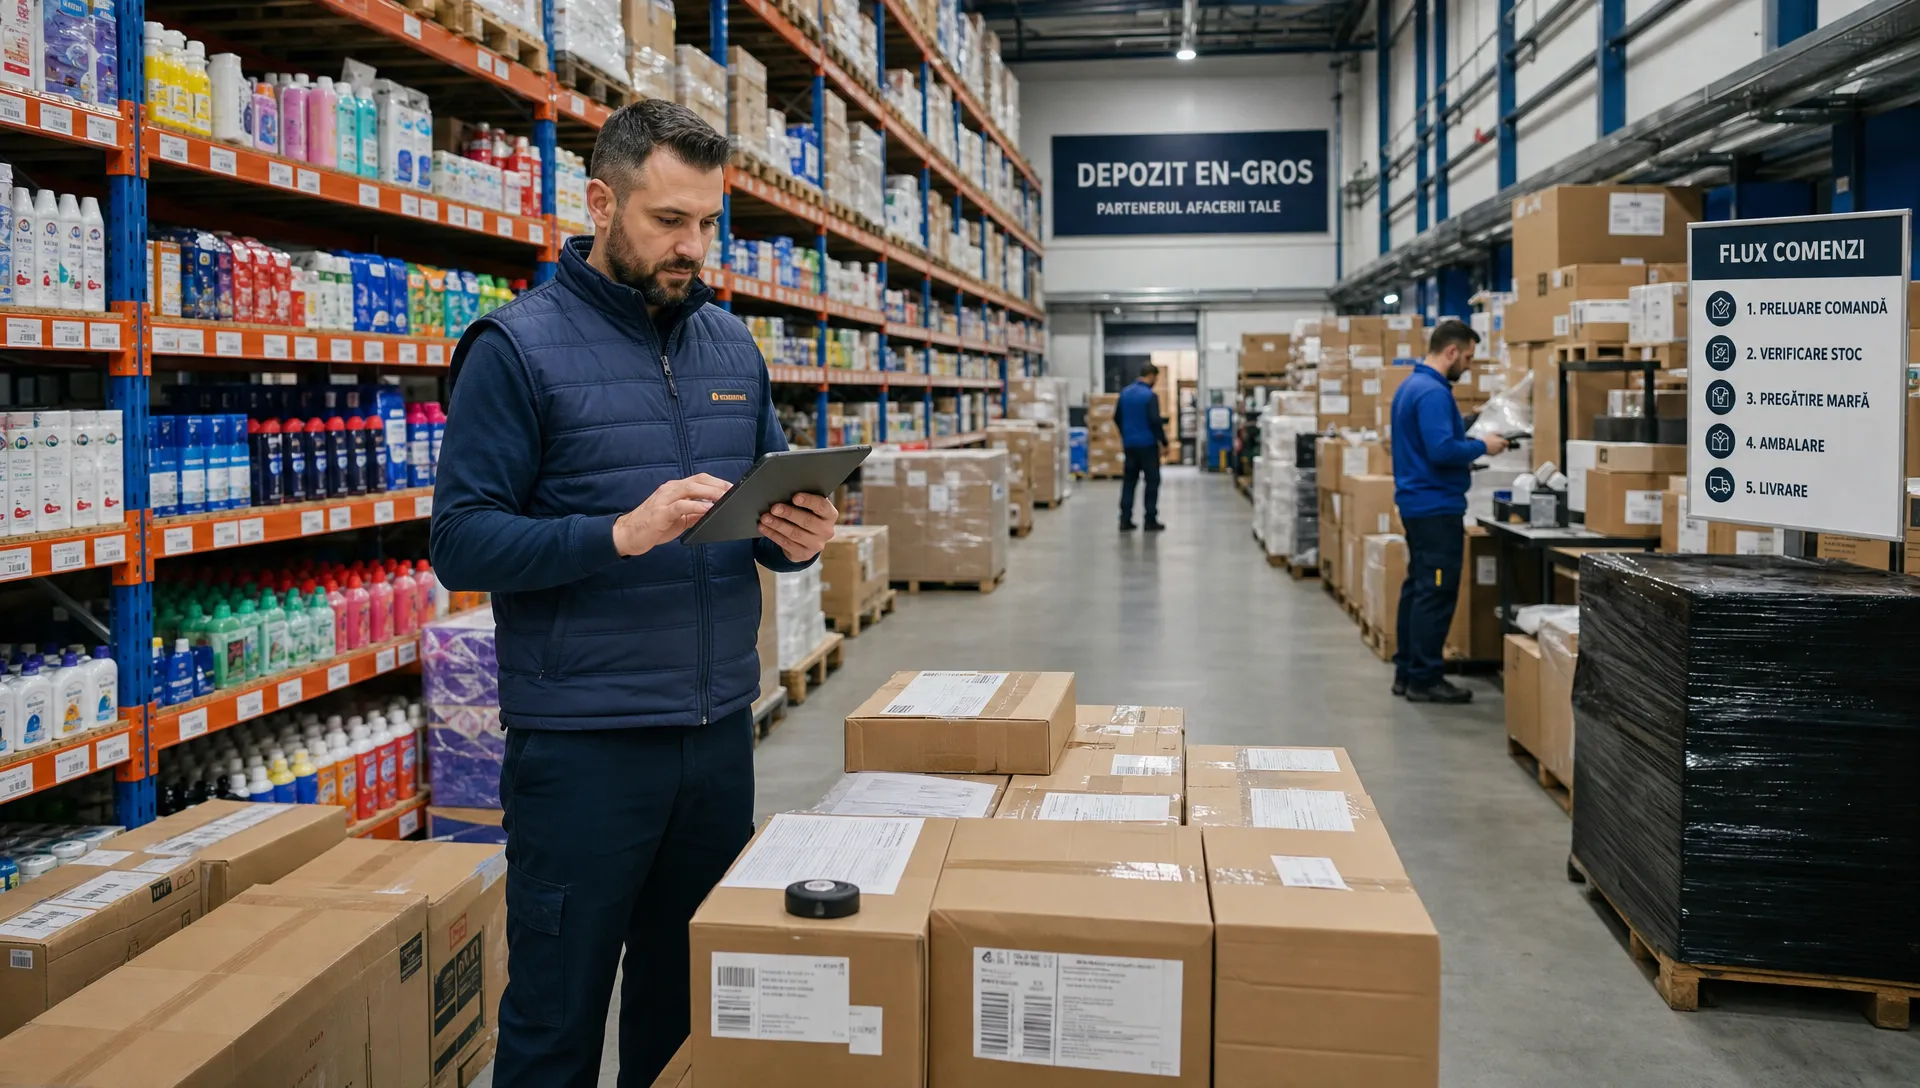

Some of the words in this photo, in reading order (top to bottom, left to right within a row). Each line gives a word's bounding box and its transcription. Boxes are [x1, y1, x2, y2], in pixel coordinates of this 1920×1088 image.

[1077, 161, 1188, 188] DEPOZIT
[1195, 159, 1314, 186] EN-GROS
[1097, 201, 1183, 216] PARTENERUL
[1186, 200, 1246, 215] AFACERII
[1249, 199, 1281, 213] TALE
[1719, 242, 1768, 263] FLUX
[1773, 239, 1865, 262] COMENZI
[1746, 302, 1756, 315] 1.
[1760, 301, 1822, 315] PRELUARE
[1824, 297, 1888, 315] COMANDĂ
[1746, 347, 1757, 360] 2.
[1760, 347, 1828, 361] VERIFICARE
[1831, 347, 1863, 361] STOC
[1746, 392, 1757, 405] 3.
[1760, 390, 1824, 407] PREGĂTIRE
[1827, 391, 1870, 409] MARFĂ
[1746, 436, 1756, 450] 4.
[1760, 436, 1825, 453] AMBALARE
[1746, 481, 1756, 494] 5.
[1759, 481, 1808, 498] LIVRARE
